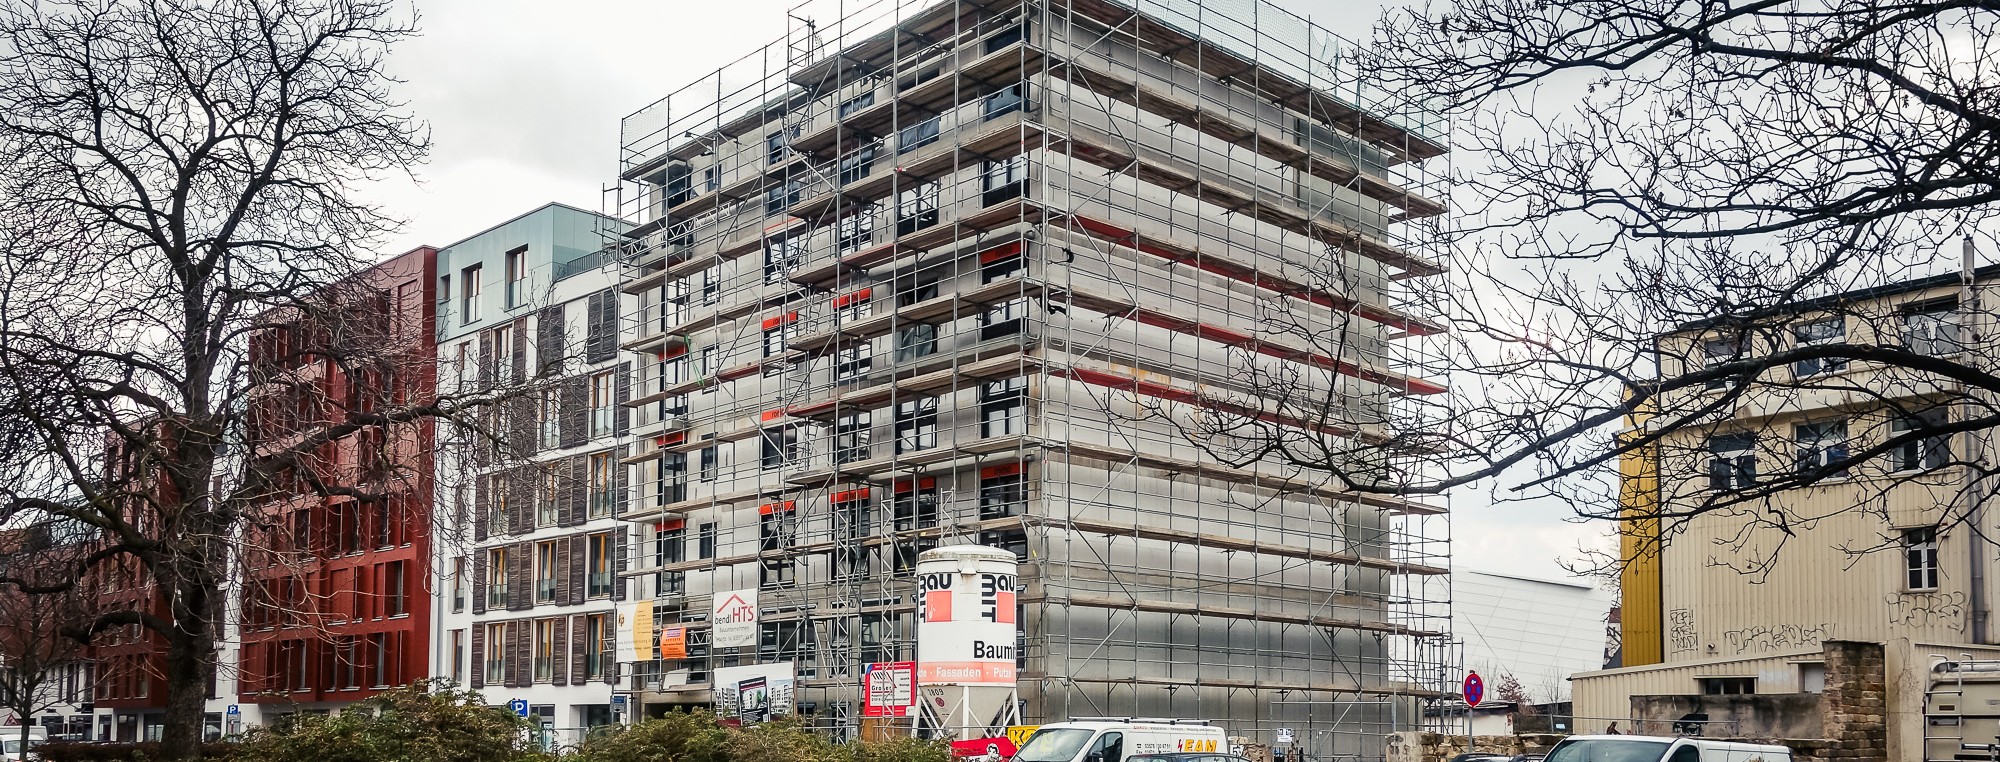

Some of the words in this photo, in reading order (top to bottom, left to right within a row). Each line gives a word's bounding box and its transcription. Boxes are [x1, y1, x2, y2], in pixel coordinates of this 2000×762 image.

[714, 614, 731, 624] bendl
[732, 605, 754, 623] HTS
[974, 640, 1016, 660] Baumi
[936, 666, 981, 678] Fassaden
[515, 702, 524, 715] P
